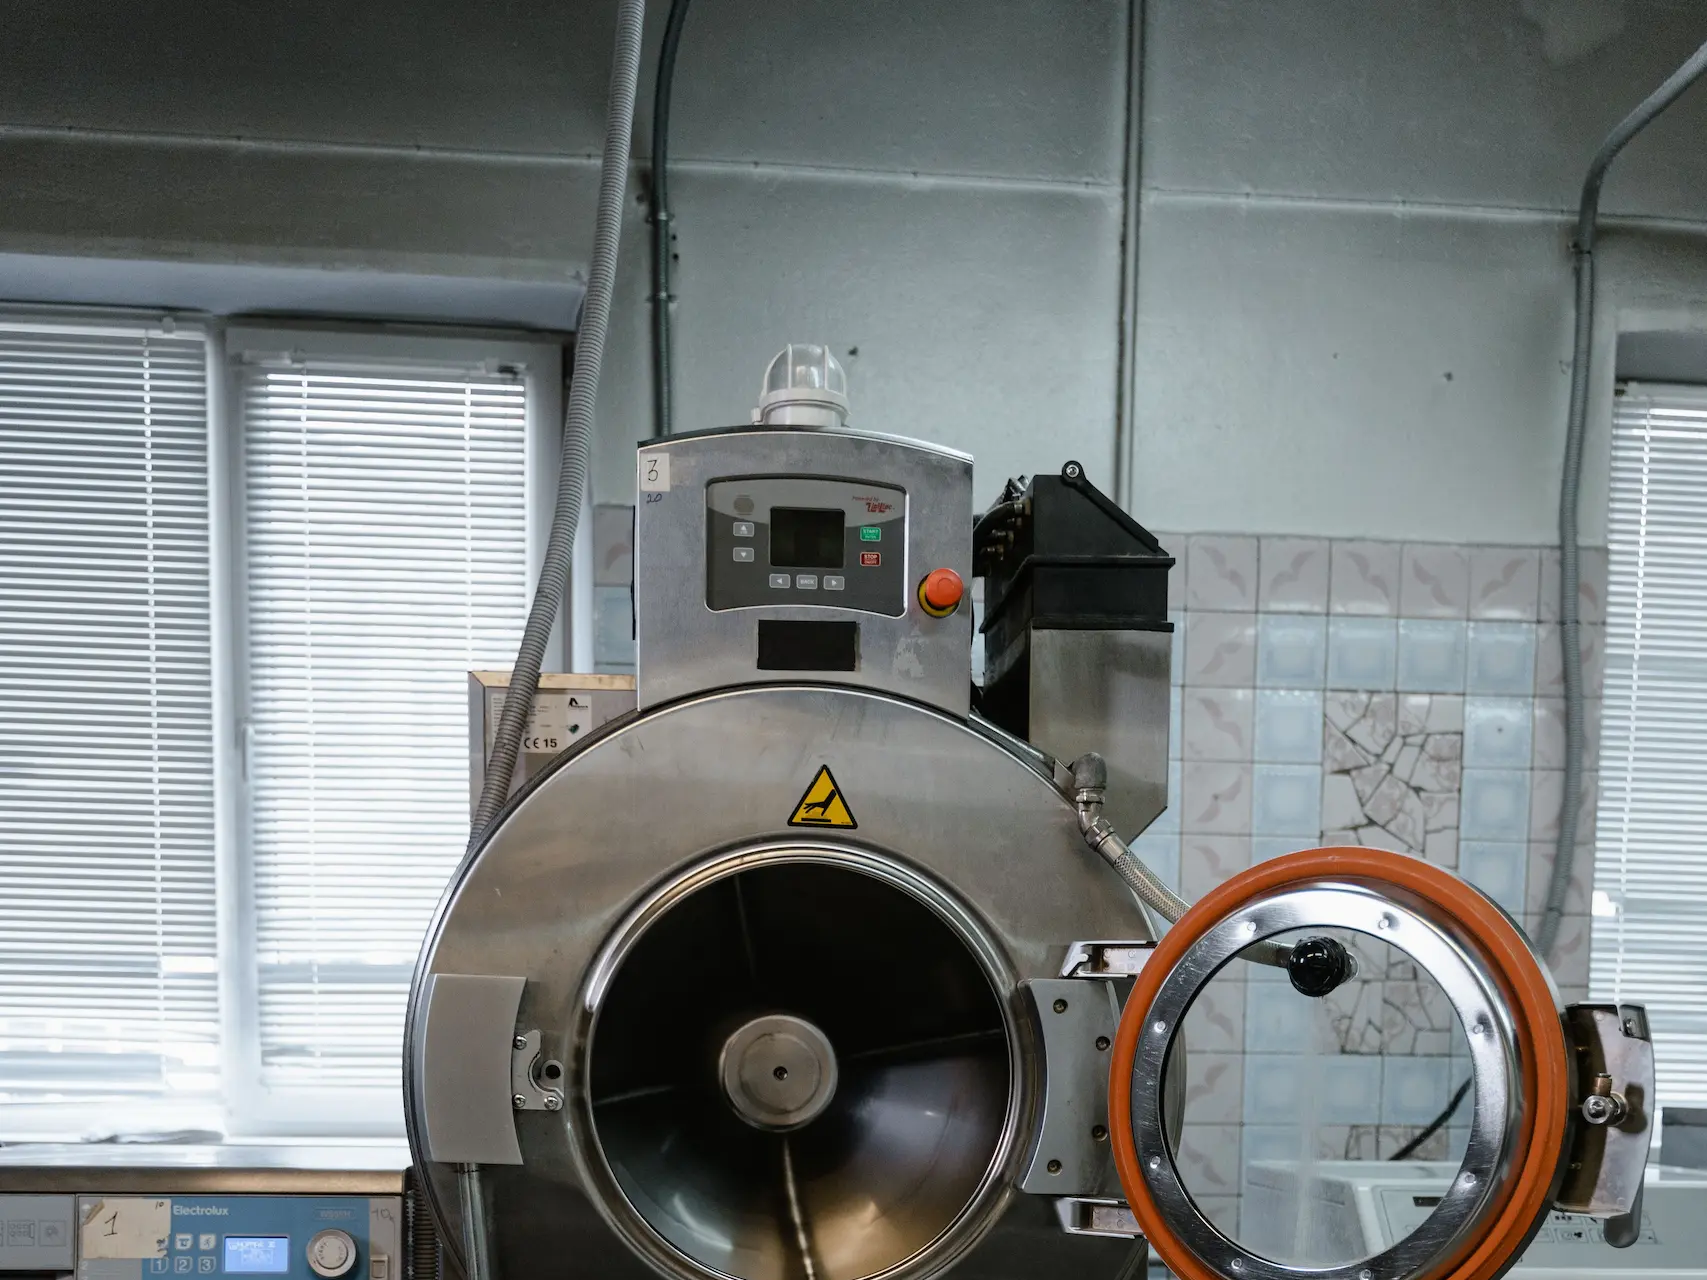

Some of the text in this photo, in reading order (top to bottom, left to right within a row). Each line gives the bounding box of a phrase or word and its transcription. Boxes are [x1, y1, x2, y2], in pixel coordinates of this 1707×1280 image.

[647, 459, 659, 482] 3
[646, 493, 663, 504] 20
[543, 738, 558, 749] 15
[172, 1205, 229, 1216] Electrolux
[103, 1211, 119, 1237] 1
[178, 1259, 189, 1272] 2
[201, 1259, 212, 1272] 3
